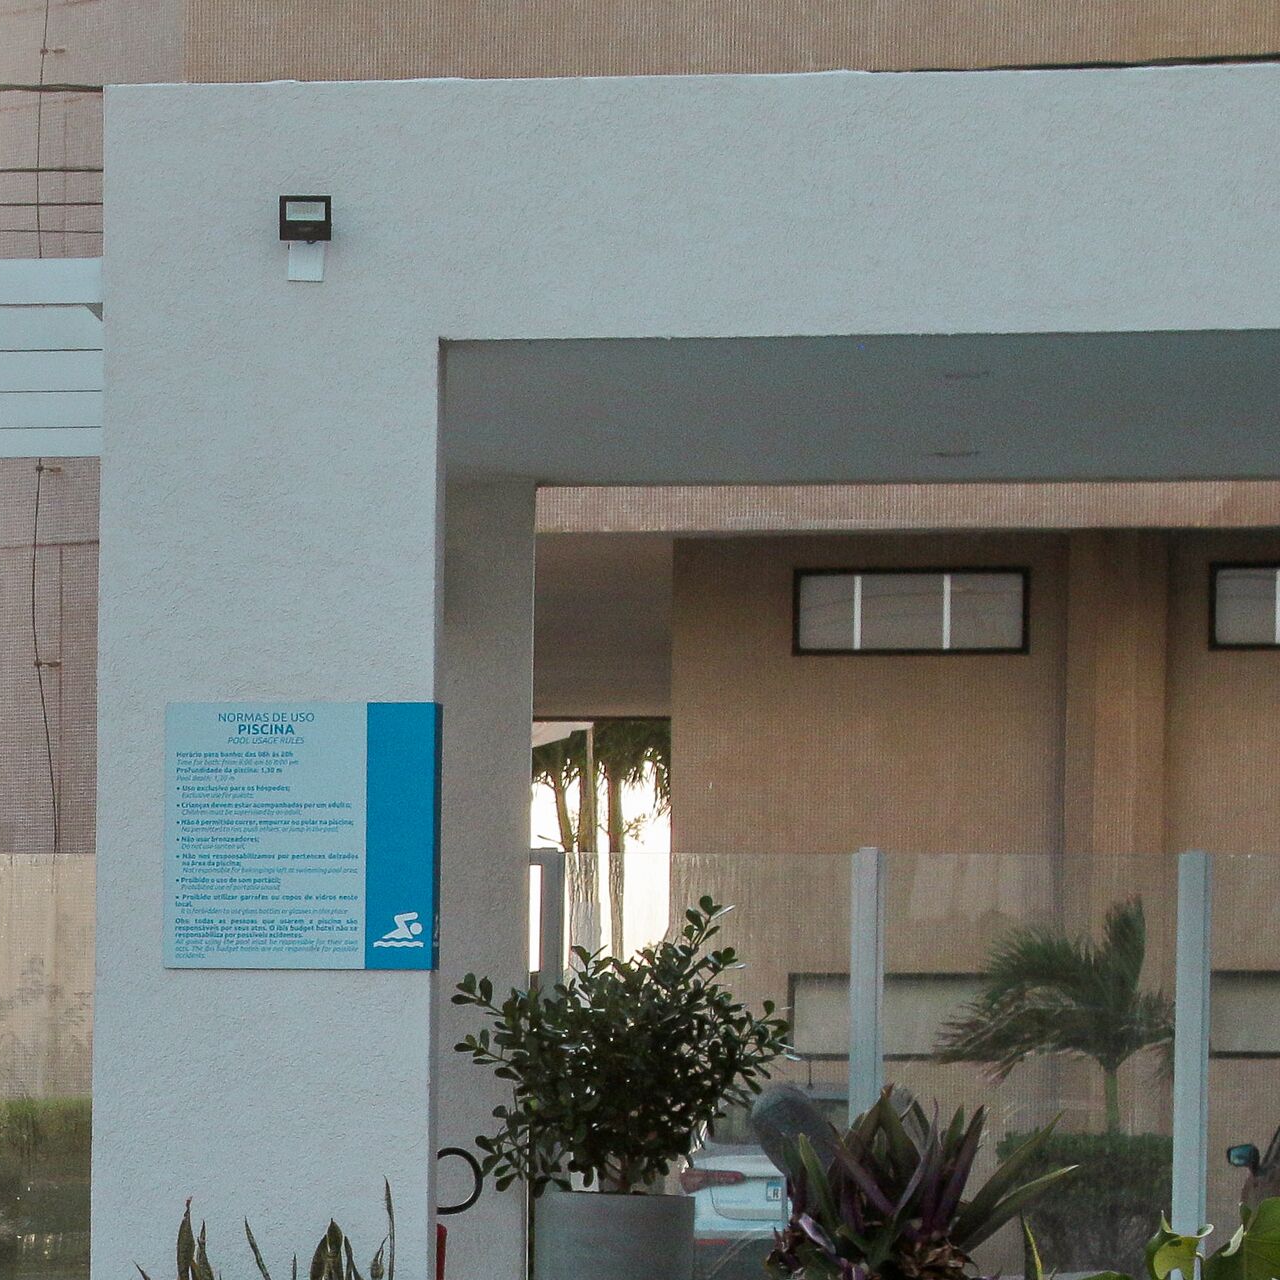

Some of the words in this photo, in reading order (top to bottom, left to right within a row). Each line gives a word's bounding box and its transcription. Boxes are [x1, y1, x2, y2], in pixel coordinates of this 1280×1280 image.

[218, 712, 270, 722] NORMAS
[272, 712, 288, 722] DE
[290, 712, 315, 722] USO
[237, 724, 295, 735] PISCINA
[252, 736, 279, 745] USAGE
[278, 736, 305, 745] RULES
